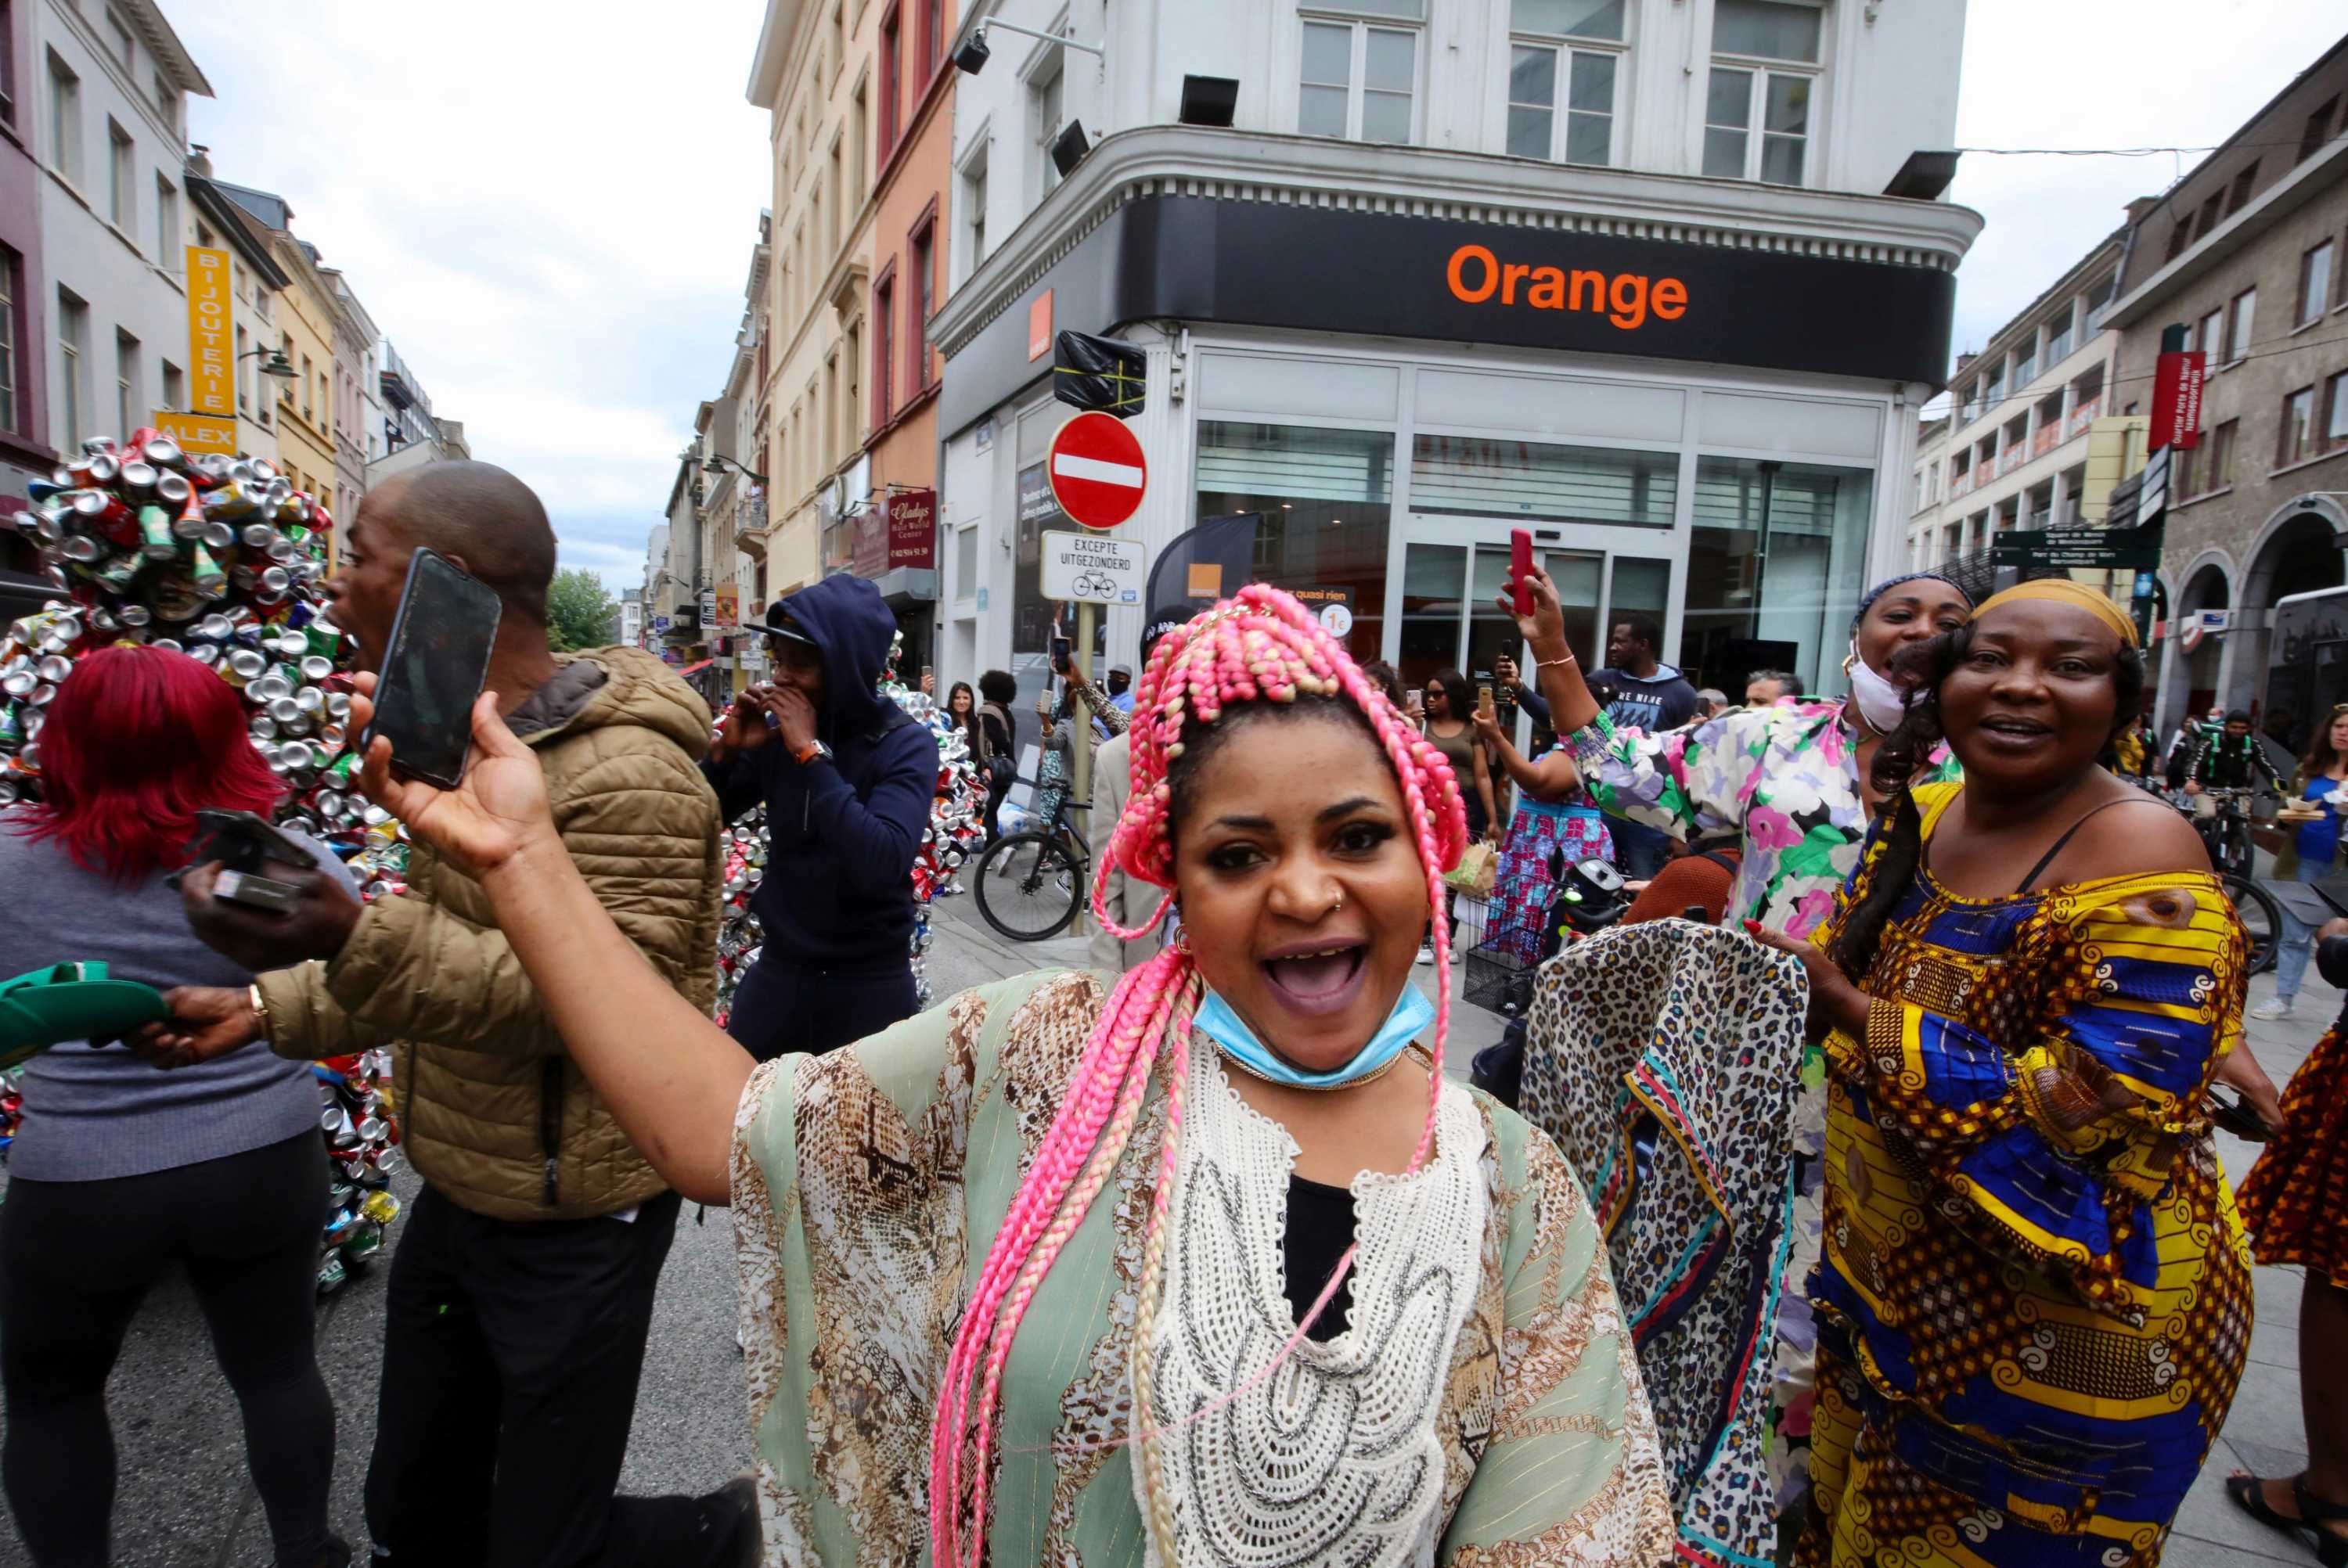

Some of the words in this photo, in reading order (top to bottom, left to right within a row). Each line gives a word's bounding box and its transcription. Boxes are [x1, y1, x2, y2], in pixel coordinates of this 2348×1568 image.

[1446, 244, 1688, 329] Orange
[198, 253, 224, 408] BIJOUTERIE
[2180, 358, 2191, 380] Namur
[2178, 382, 2189, 391] de
[2176, 394, 2188, 414] Porte
[160, 423, 233, 445] ALEX
[2173, 416, 2185, 444] Quartier
[891, 501, 930, 526] Gladys
[1075, 539, 1118, 555] EXCEPTE
[1061, 553, 1130, 570] UITGEZONDERD
[1296, 589, 1324, 600] quasi
[1327, 591, 1346, 601] rien
